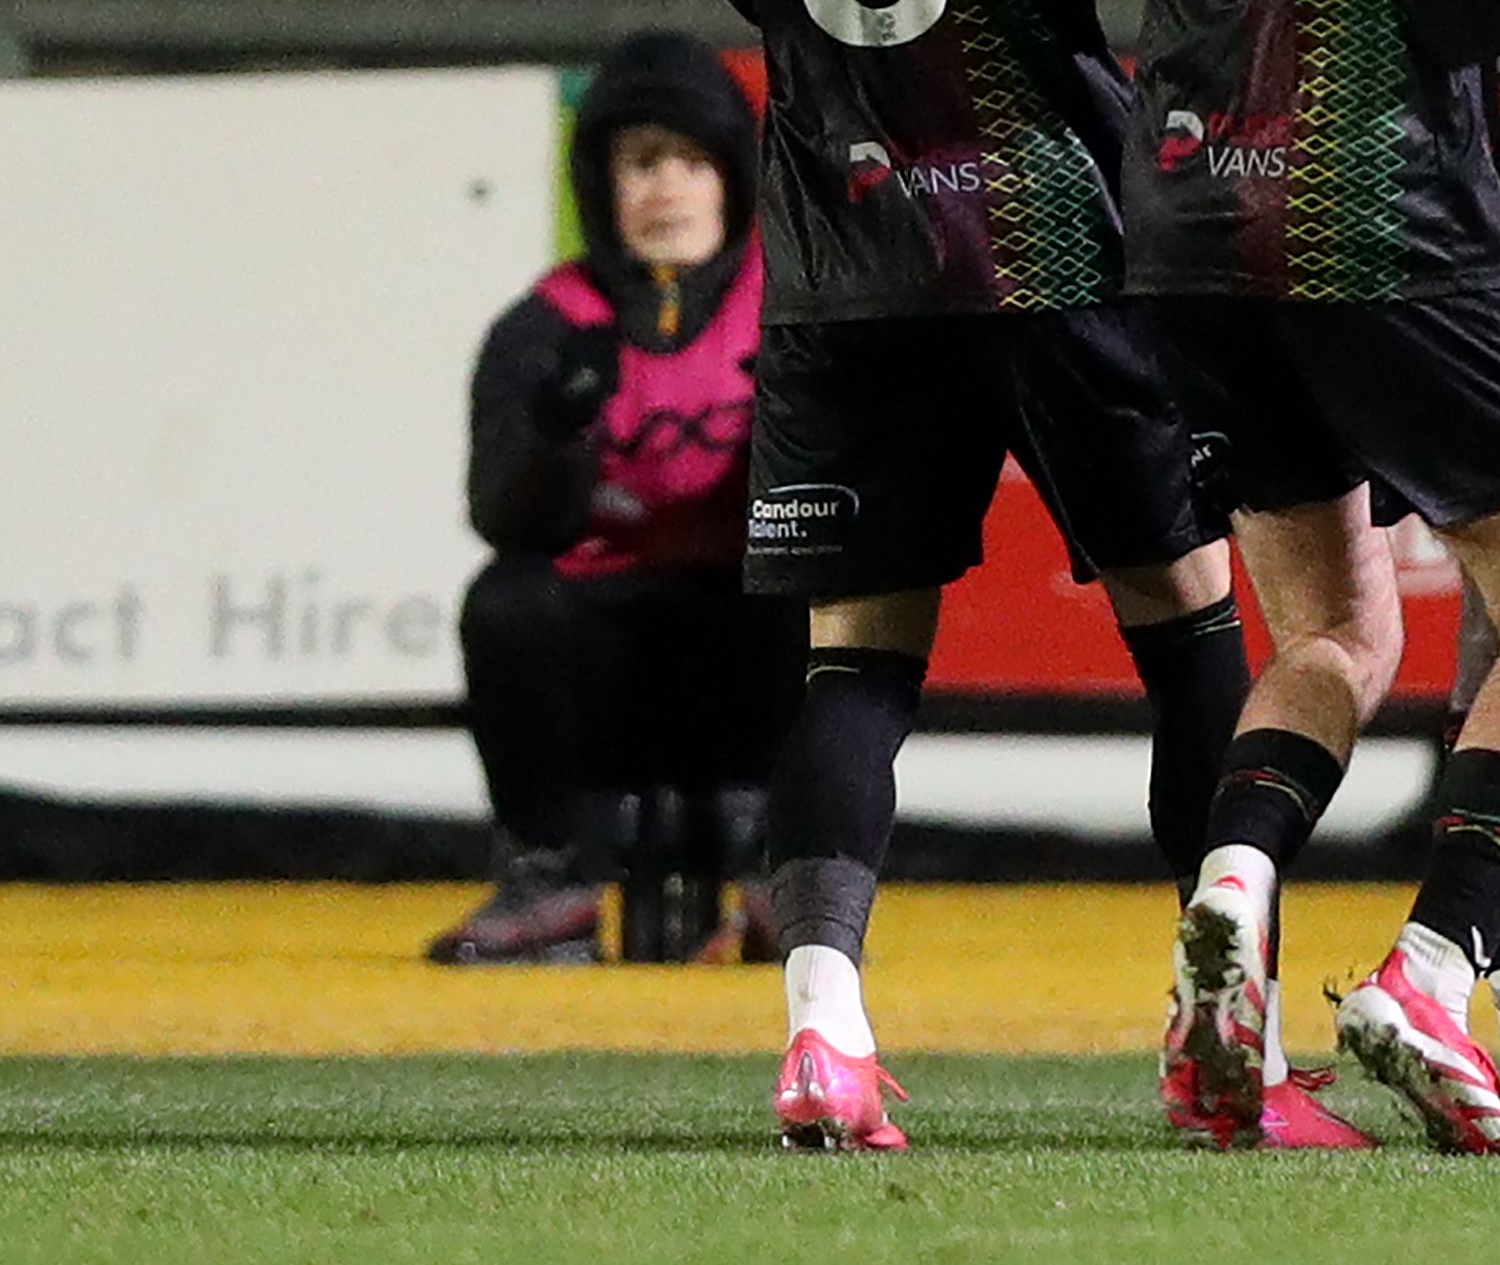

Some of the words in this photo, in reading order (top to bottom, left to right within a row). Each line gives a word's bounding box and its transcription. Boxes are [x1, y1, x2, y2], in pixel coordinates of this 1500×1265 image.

[1206, 145, 1288, 179] VANS
[895, 162, 982, 200] VANS
[752, 499, 839, 519] Candour
[205, 572, 443, 660] Hire
